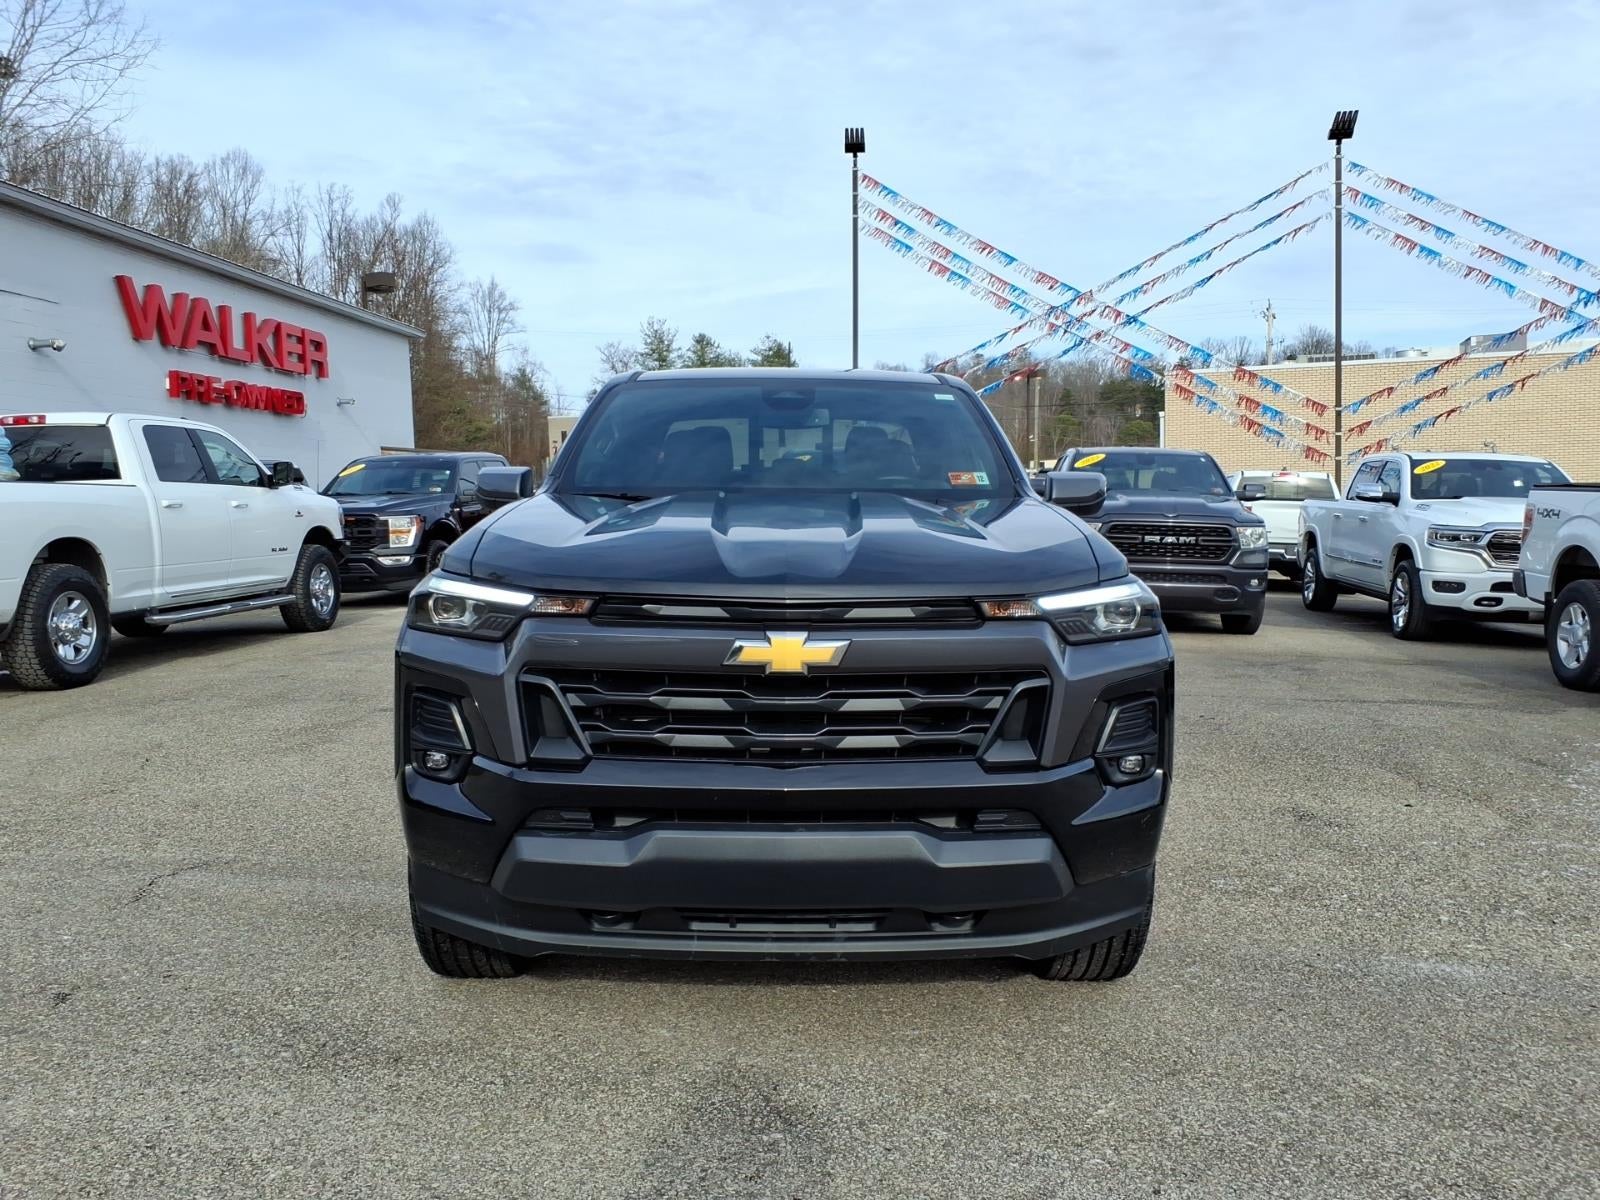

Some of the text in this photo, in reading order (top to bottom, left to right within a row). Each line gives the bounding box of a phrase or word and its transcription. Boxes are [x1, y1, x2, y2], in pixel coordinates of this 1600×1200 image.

[113, 274, 329, 378] WALKER
[168, 370, 306, 415] PRE-OWNED
[1144, 535, 1197, 544] RAM
